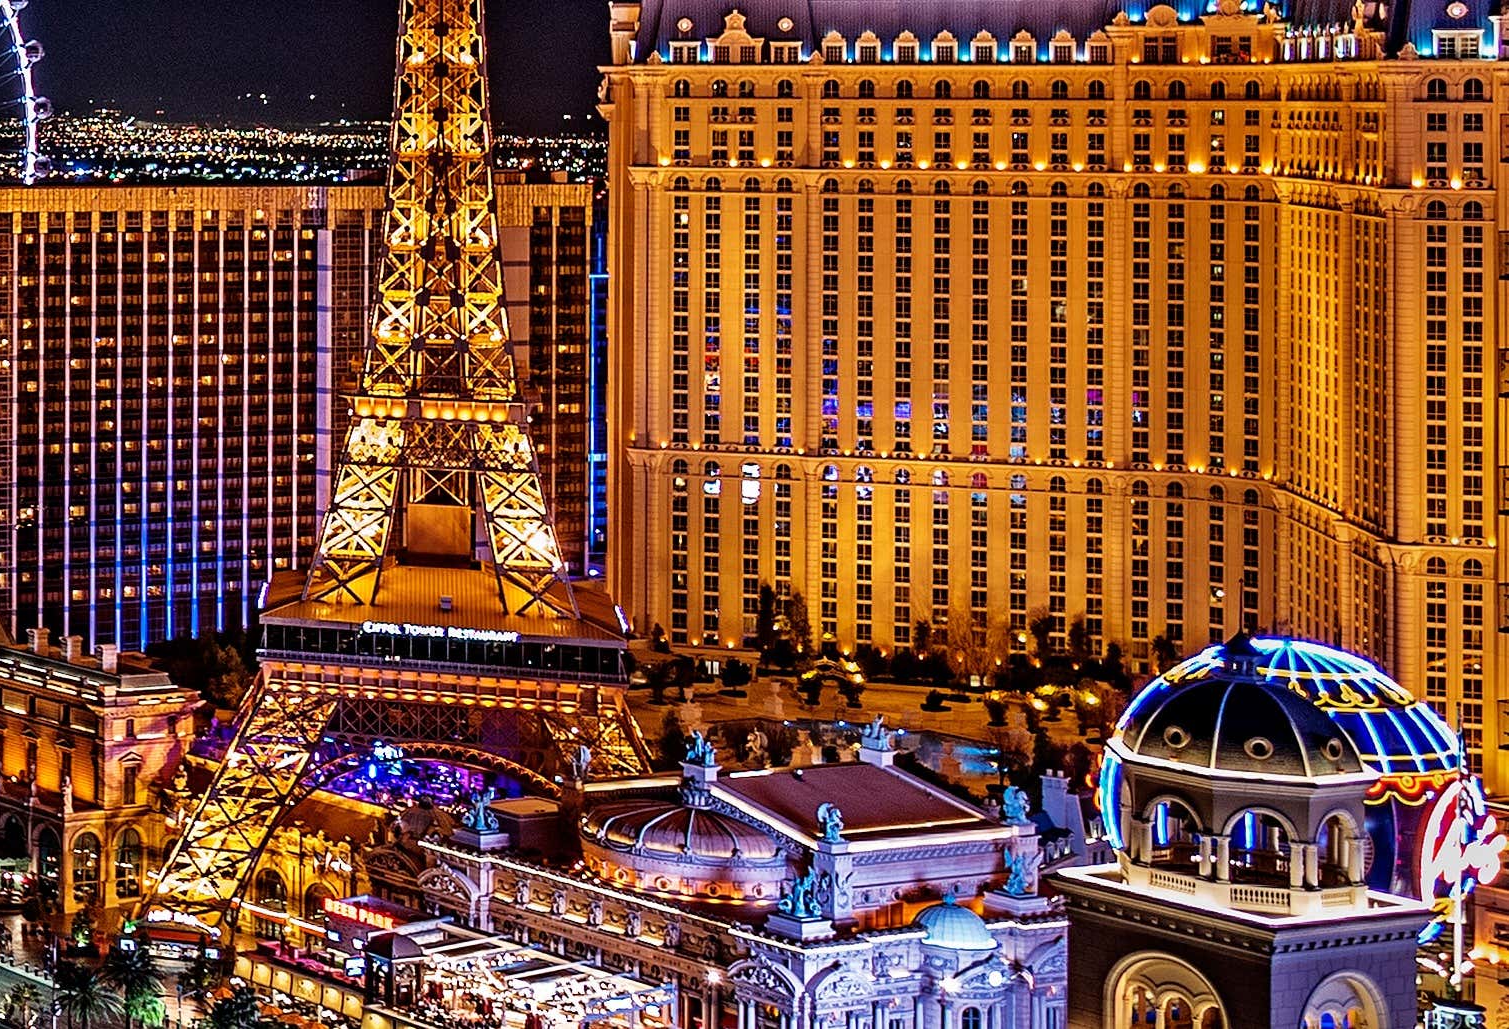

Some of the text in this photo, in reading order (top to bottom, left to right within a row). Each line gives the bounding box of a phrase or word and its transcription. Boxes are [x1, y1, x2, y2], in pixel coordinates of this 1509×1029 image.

[404, 623, 445, 637] TOWER
[448, 626, 518, 642] RESTAURANT
[324, 897, 394, 931] BEER PARK
